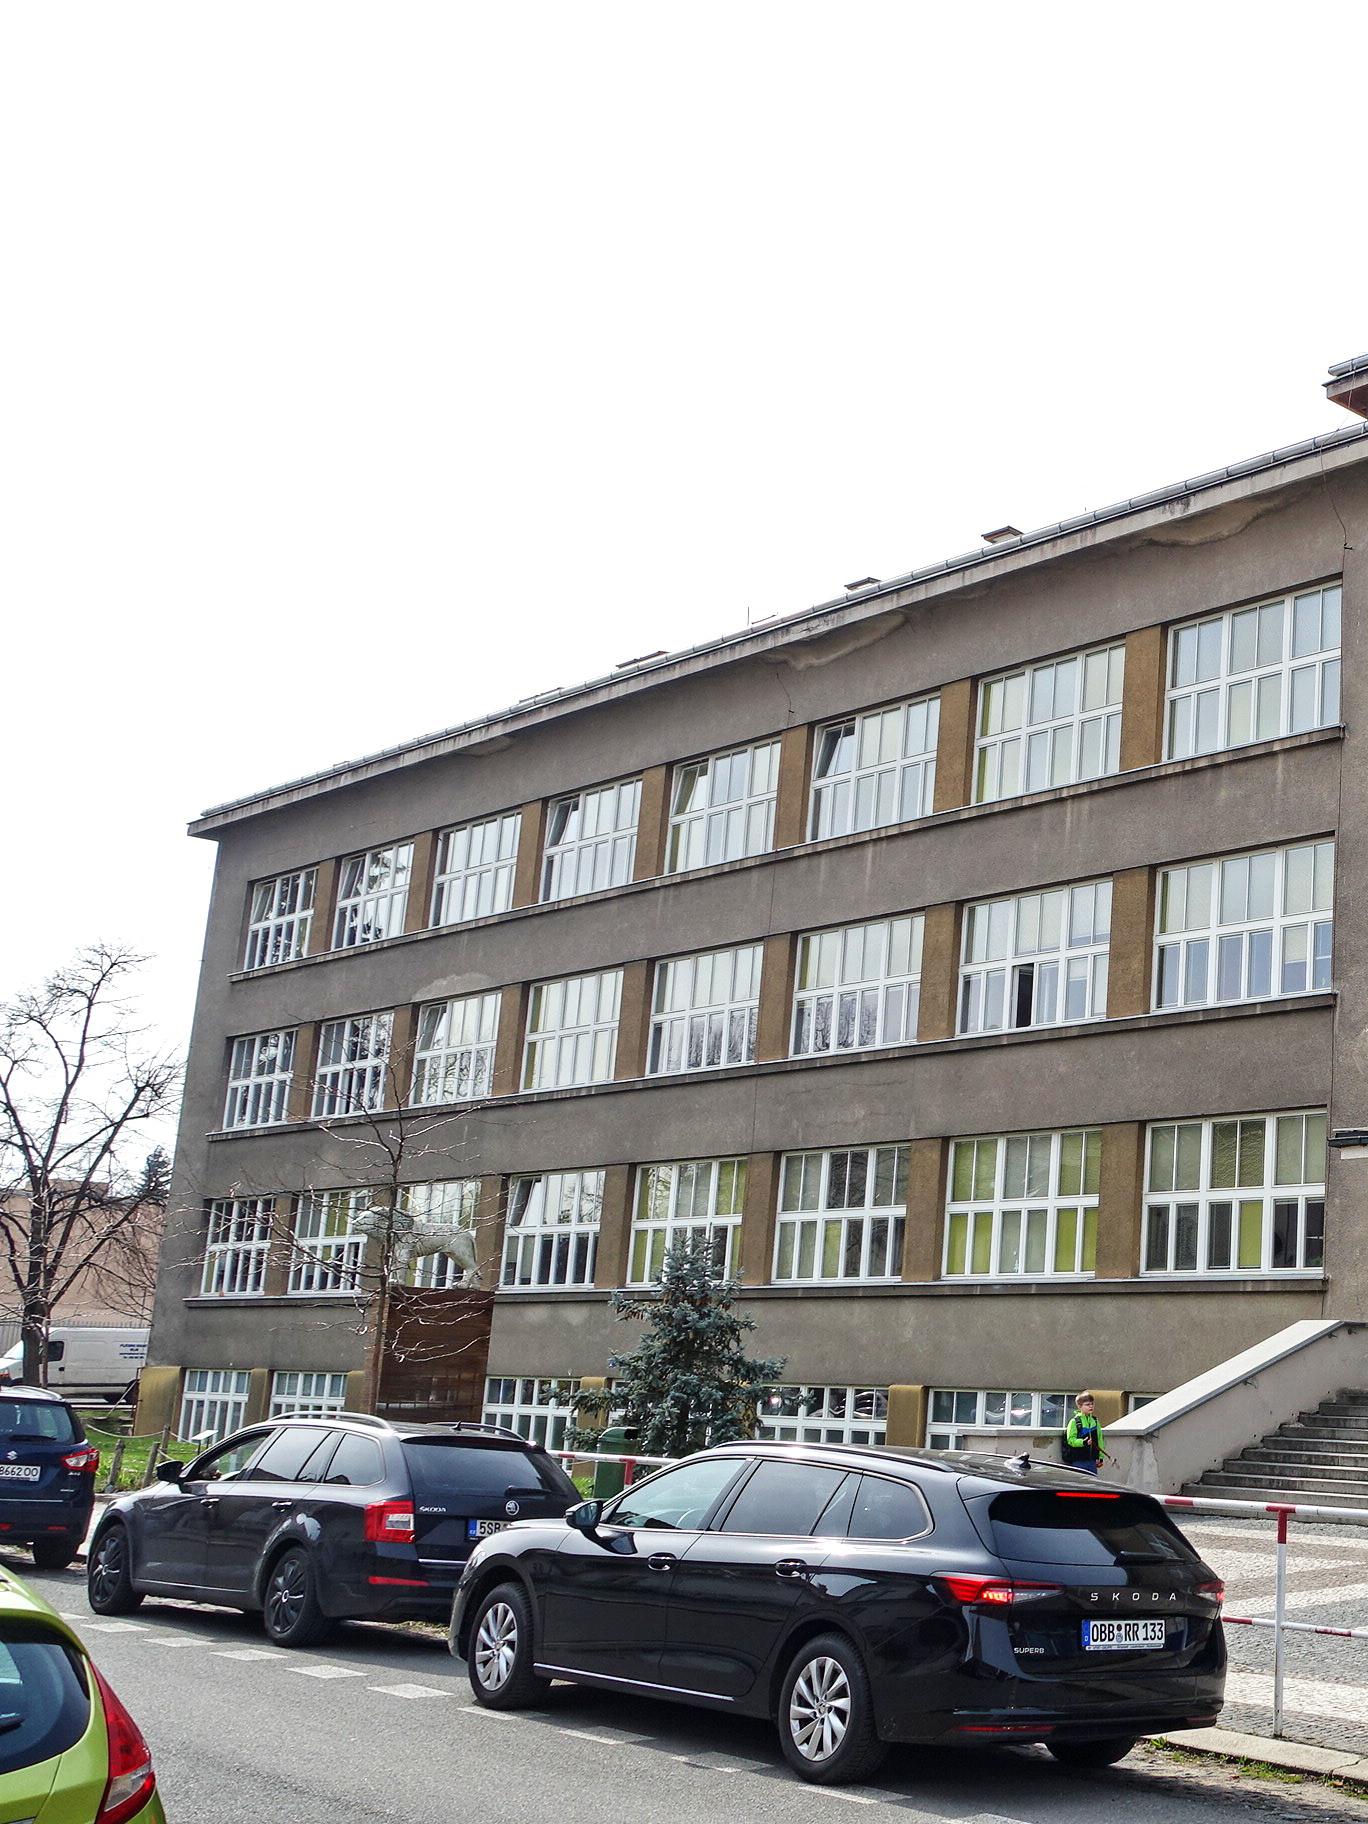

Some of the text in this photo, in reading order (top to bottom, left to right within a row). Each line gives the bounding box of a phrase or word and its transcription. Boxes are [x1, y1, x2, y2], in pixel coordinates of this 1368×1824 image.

[1091, 1623, 1163, 1642] OBB RR 133
